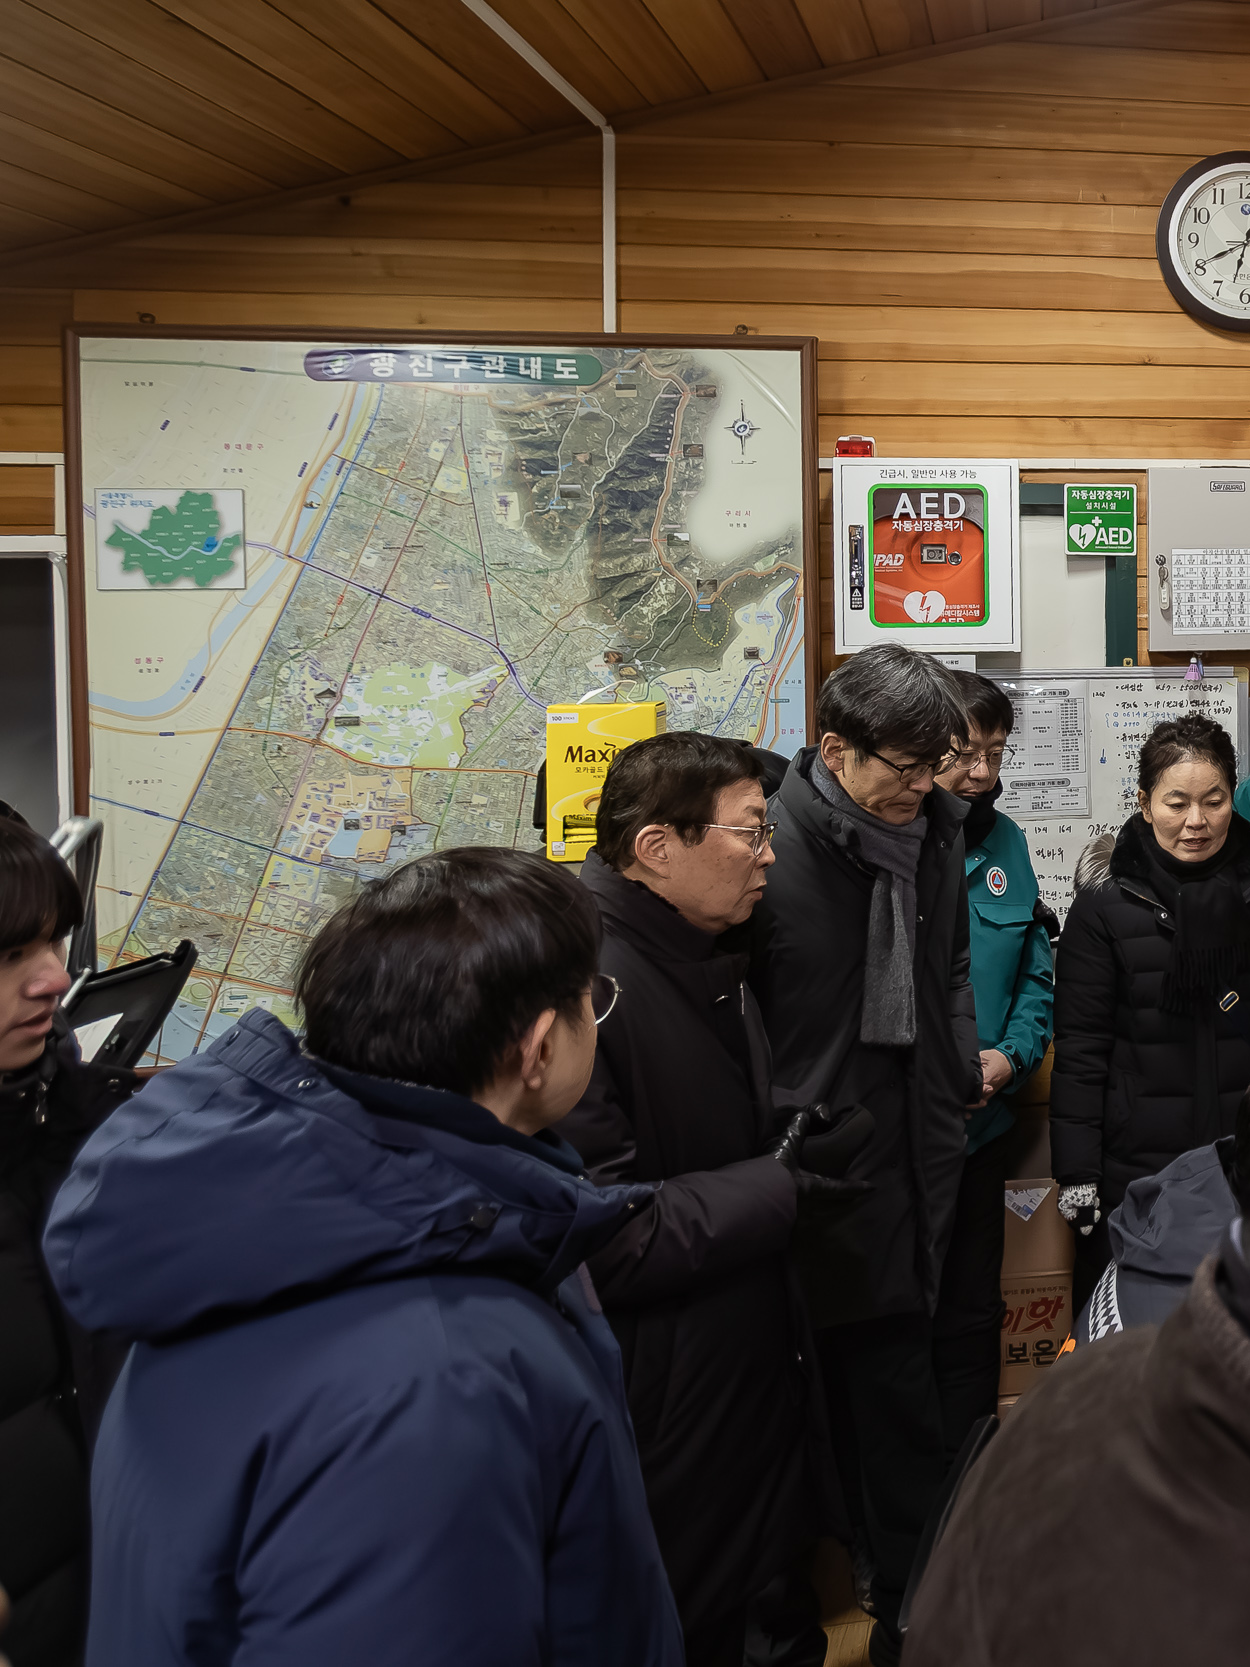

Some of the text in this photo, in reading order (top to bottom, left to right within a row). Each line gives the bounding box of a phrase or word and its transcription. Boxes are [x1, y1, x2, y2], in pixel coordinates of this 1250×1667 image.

[1212, 188, 1225, 205] 11
[1193, 207, 1210, 225] 10
[1187, 232, 1200, 249] 9
[1194, 258, 1207, 276] 8
[1212, 279, 1223, 297] 7
[879, 469, 978, 480] 긴급시, 일반인 사용 가능
[1071, 489, 1130, 501] 자동심장충격기
[725, 509, 751, 517] 구리시
[892, 492, 967, 520] AED
[1085, 502, 1117, 510] 설치시설
[892, 520, 964, 532] 자동심장충격기
[1095, 527, 1133, 545] AED
[564, 742, 621, 764] Maxi
[575, 766, 604, 774] 모카골드
[1005, 1338, 1067, 1368] 보온
